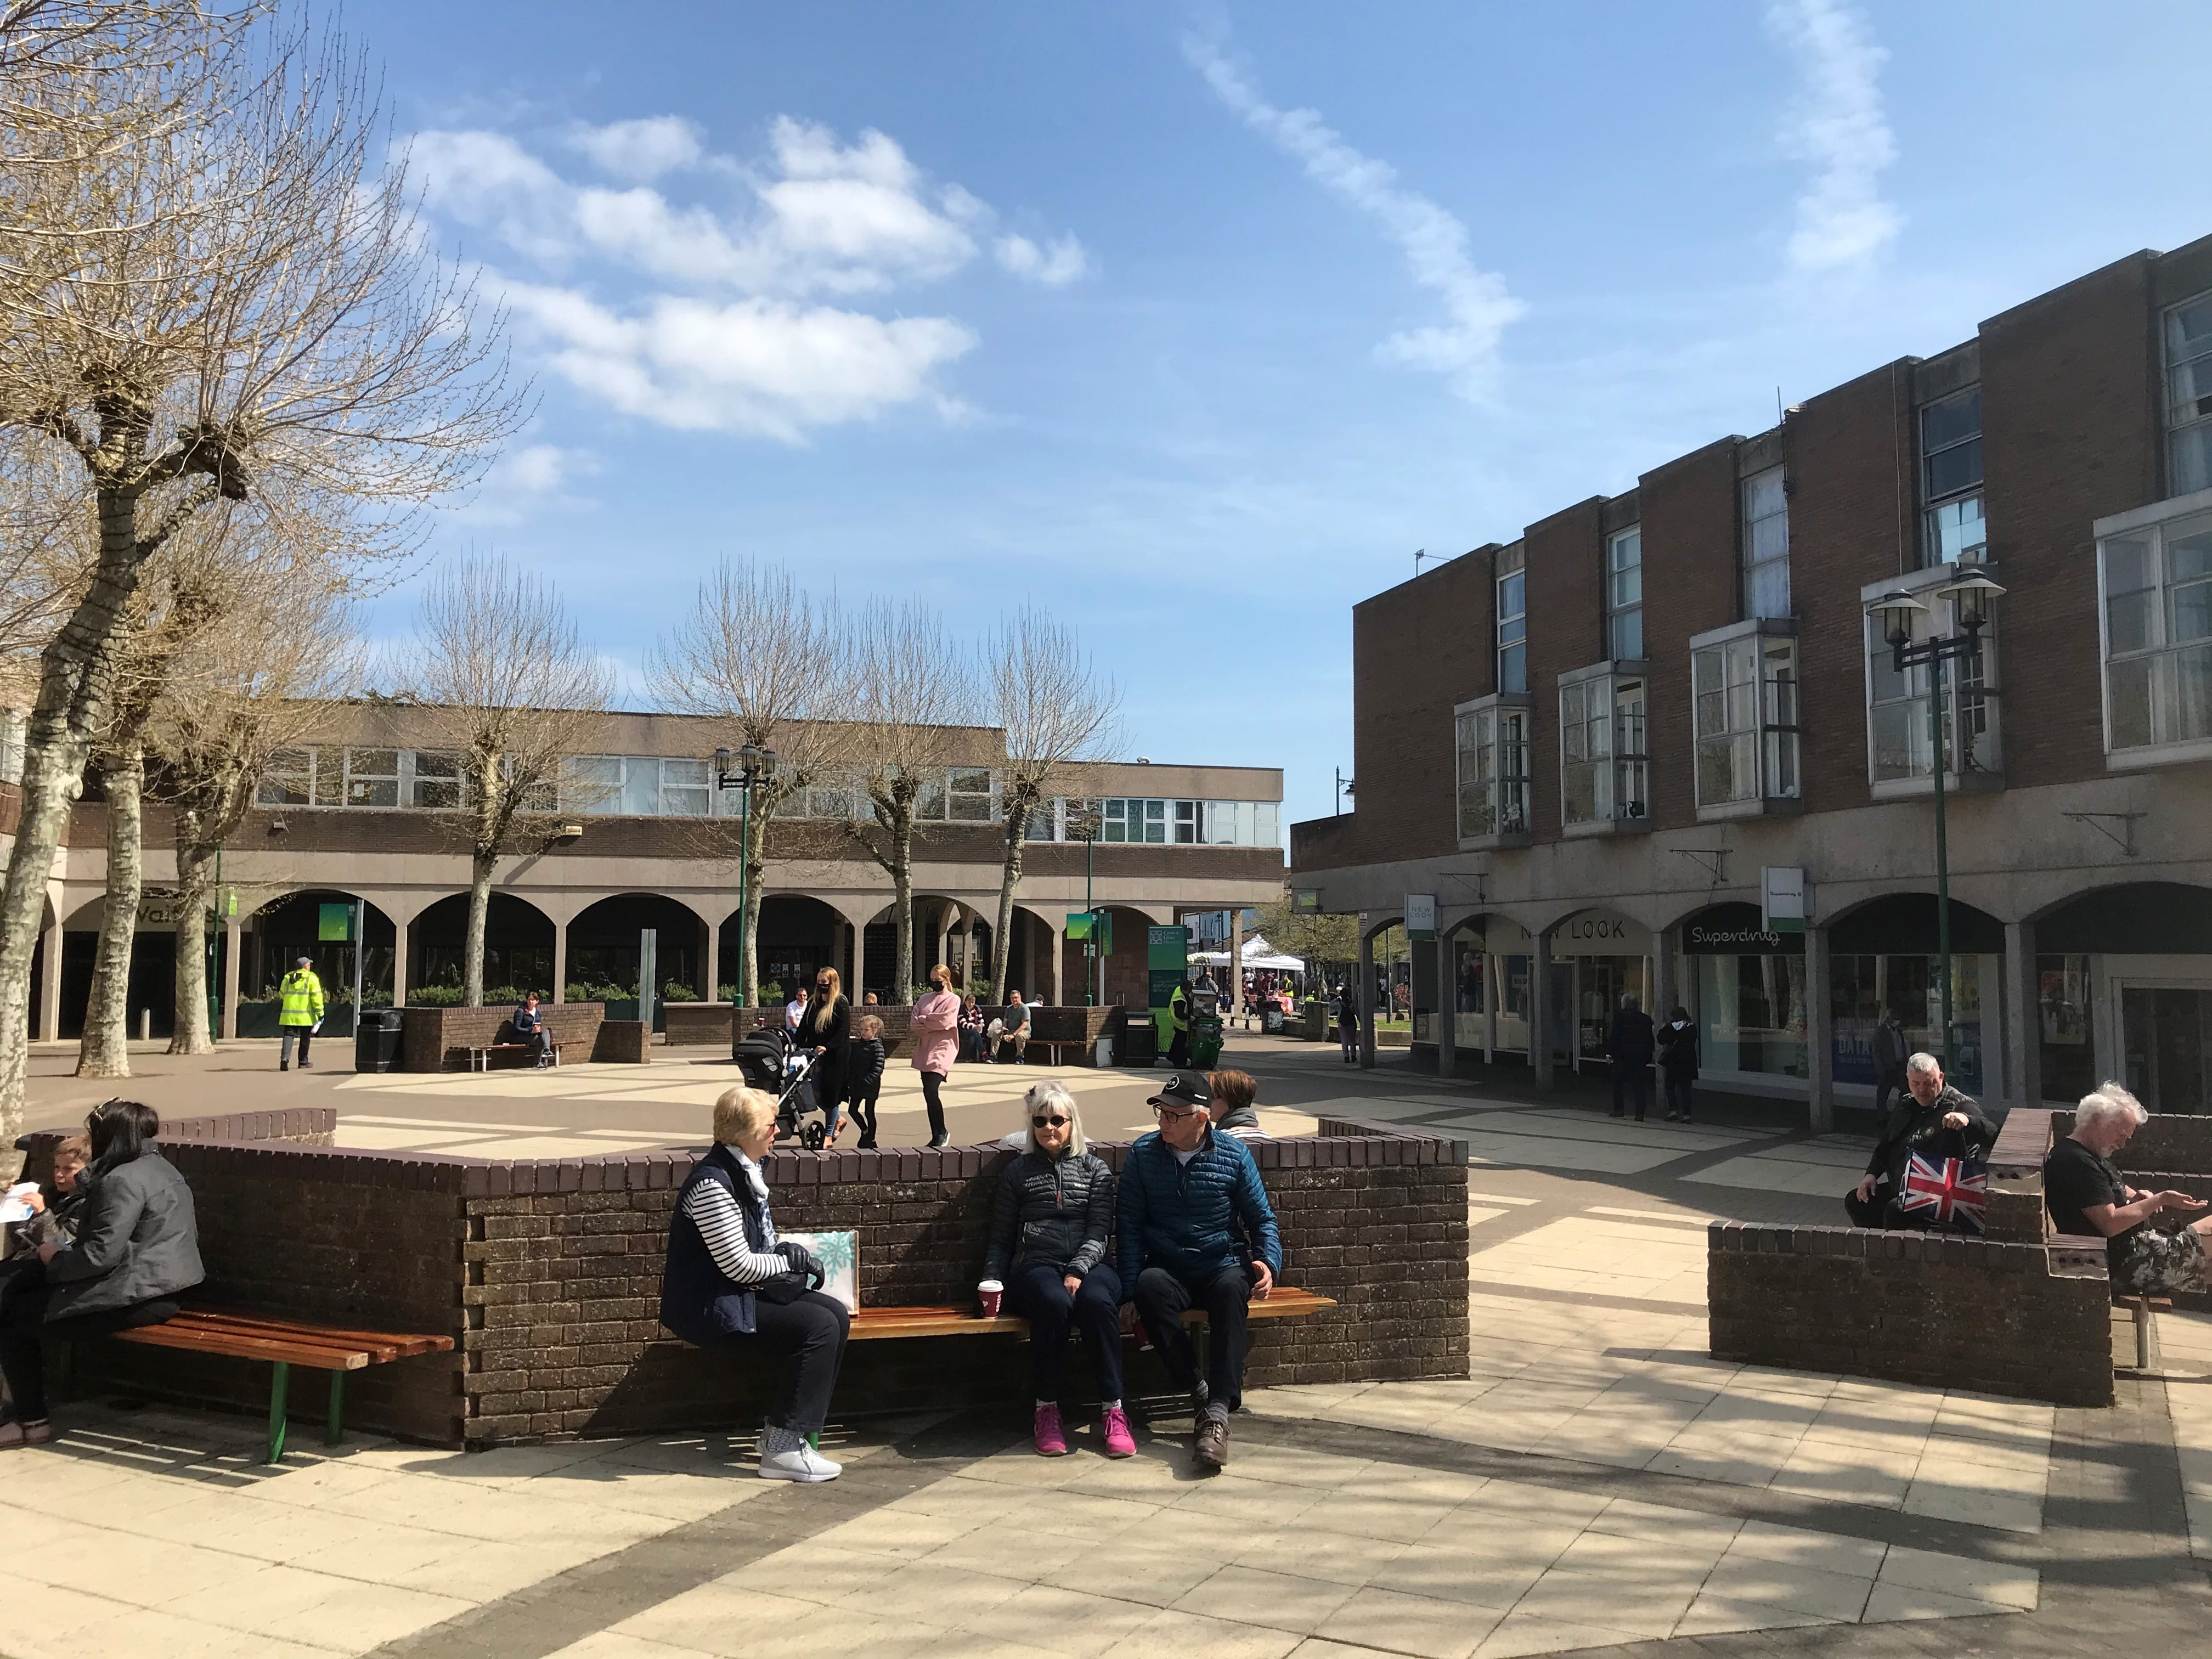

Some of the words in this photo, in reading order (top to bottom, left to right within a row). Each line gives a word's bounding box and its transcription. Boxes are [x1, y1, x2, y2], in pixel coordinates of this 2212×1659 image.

[1522, 926, 1560, 940] NW
[1571, 920, 1624, 939] LOOK
[1692, 927, 1780, 947] Superdrug
[1838, 1035, 1870, 1054] DATA
